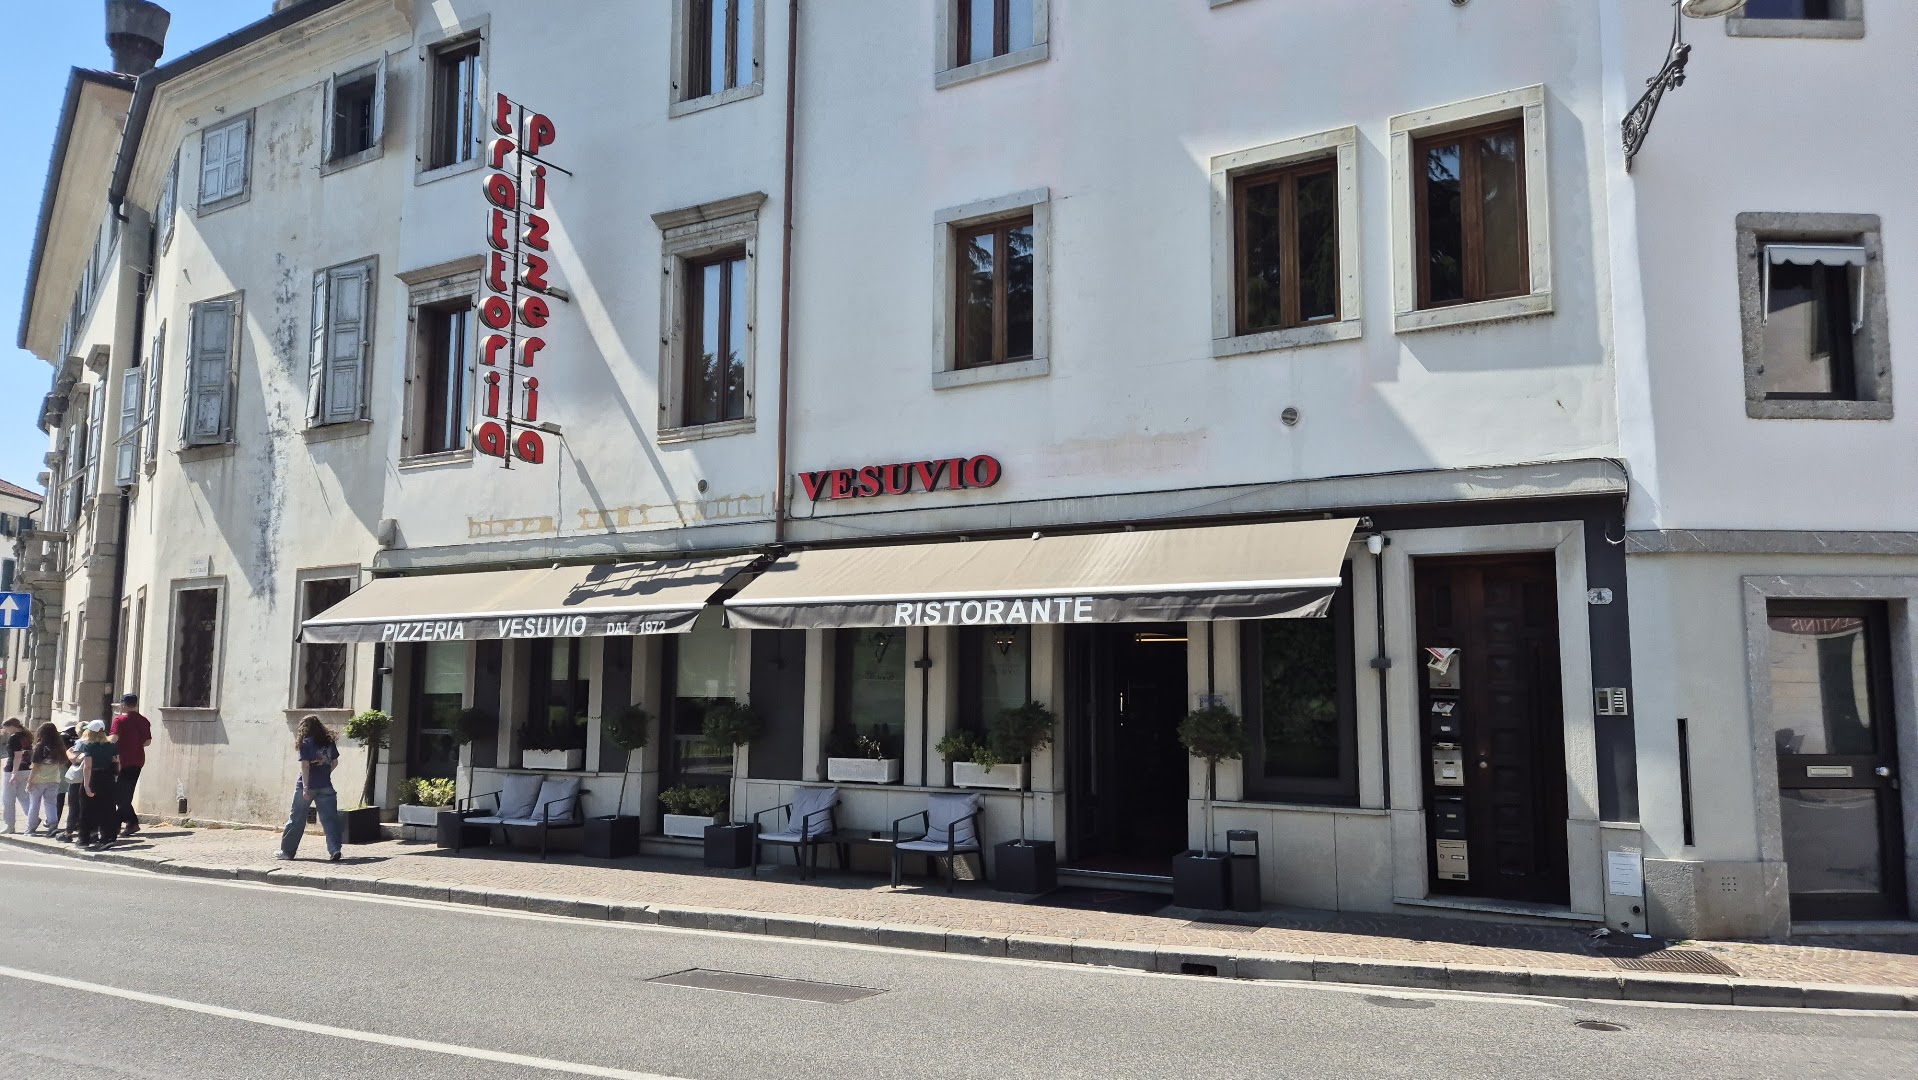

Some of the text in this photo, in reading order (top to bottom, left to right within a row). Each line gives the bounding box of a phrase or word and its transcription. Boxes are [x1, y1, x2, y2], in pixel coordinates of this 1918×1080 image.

[473, 92, 516, 458] trattoria
[798, 454, 1002, 501] VESUVIO
[381, 616, 666, 641] PIZZERIA VESUVIO DAL 1972
[894, 596, 1094, 626] RISTORANTE
